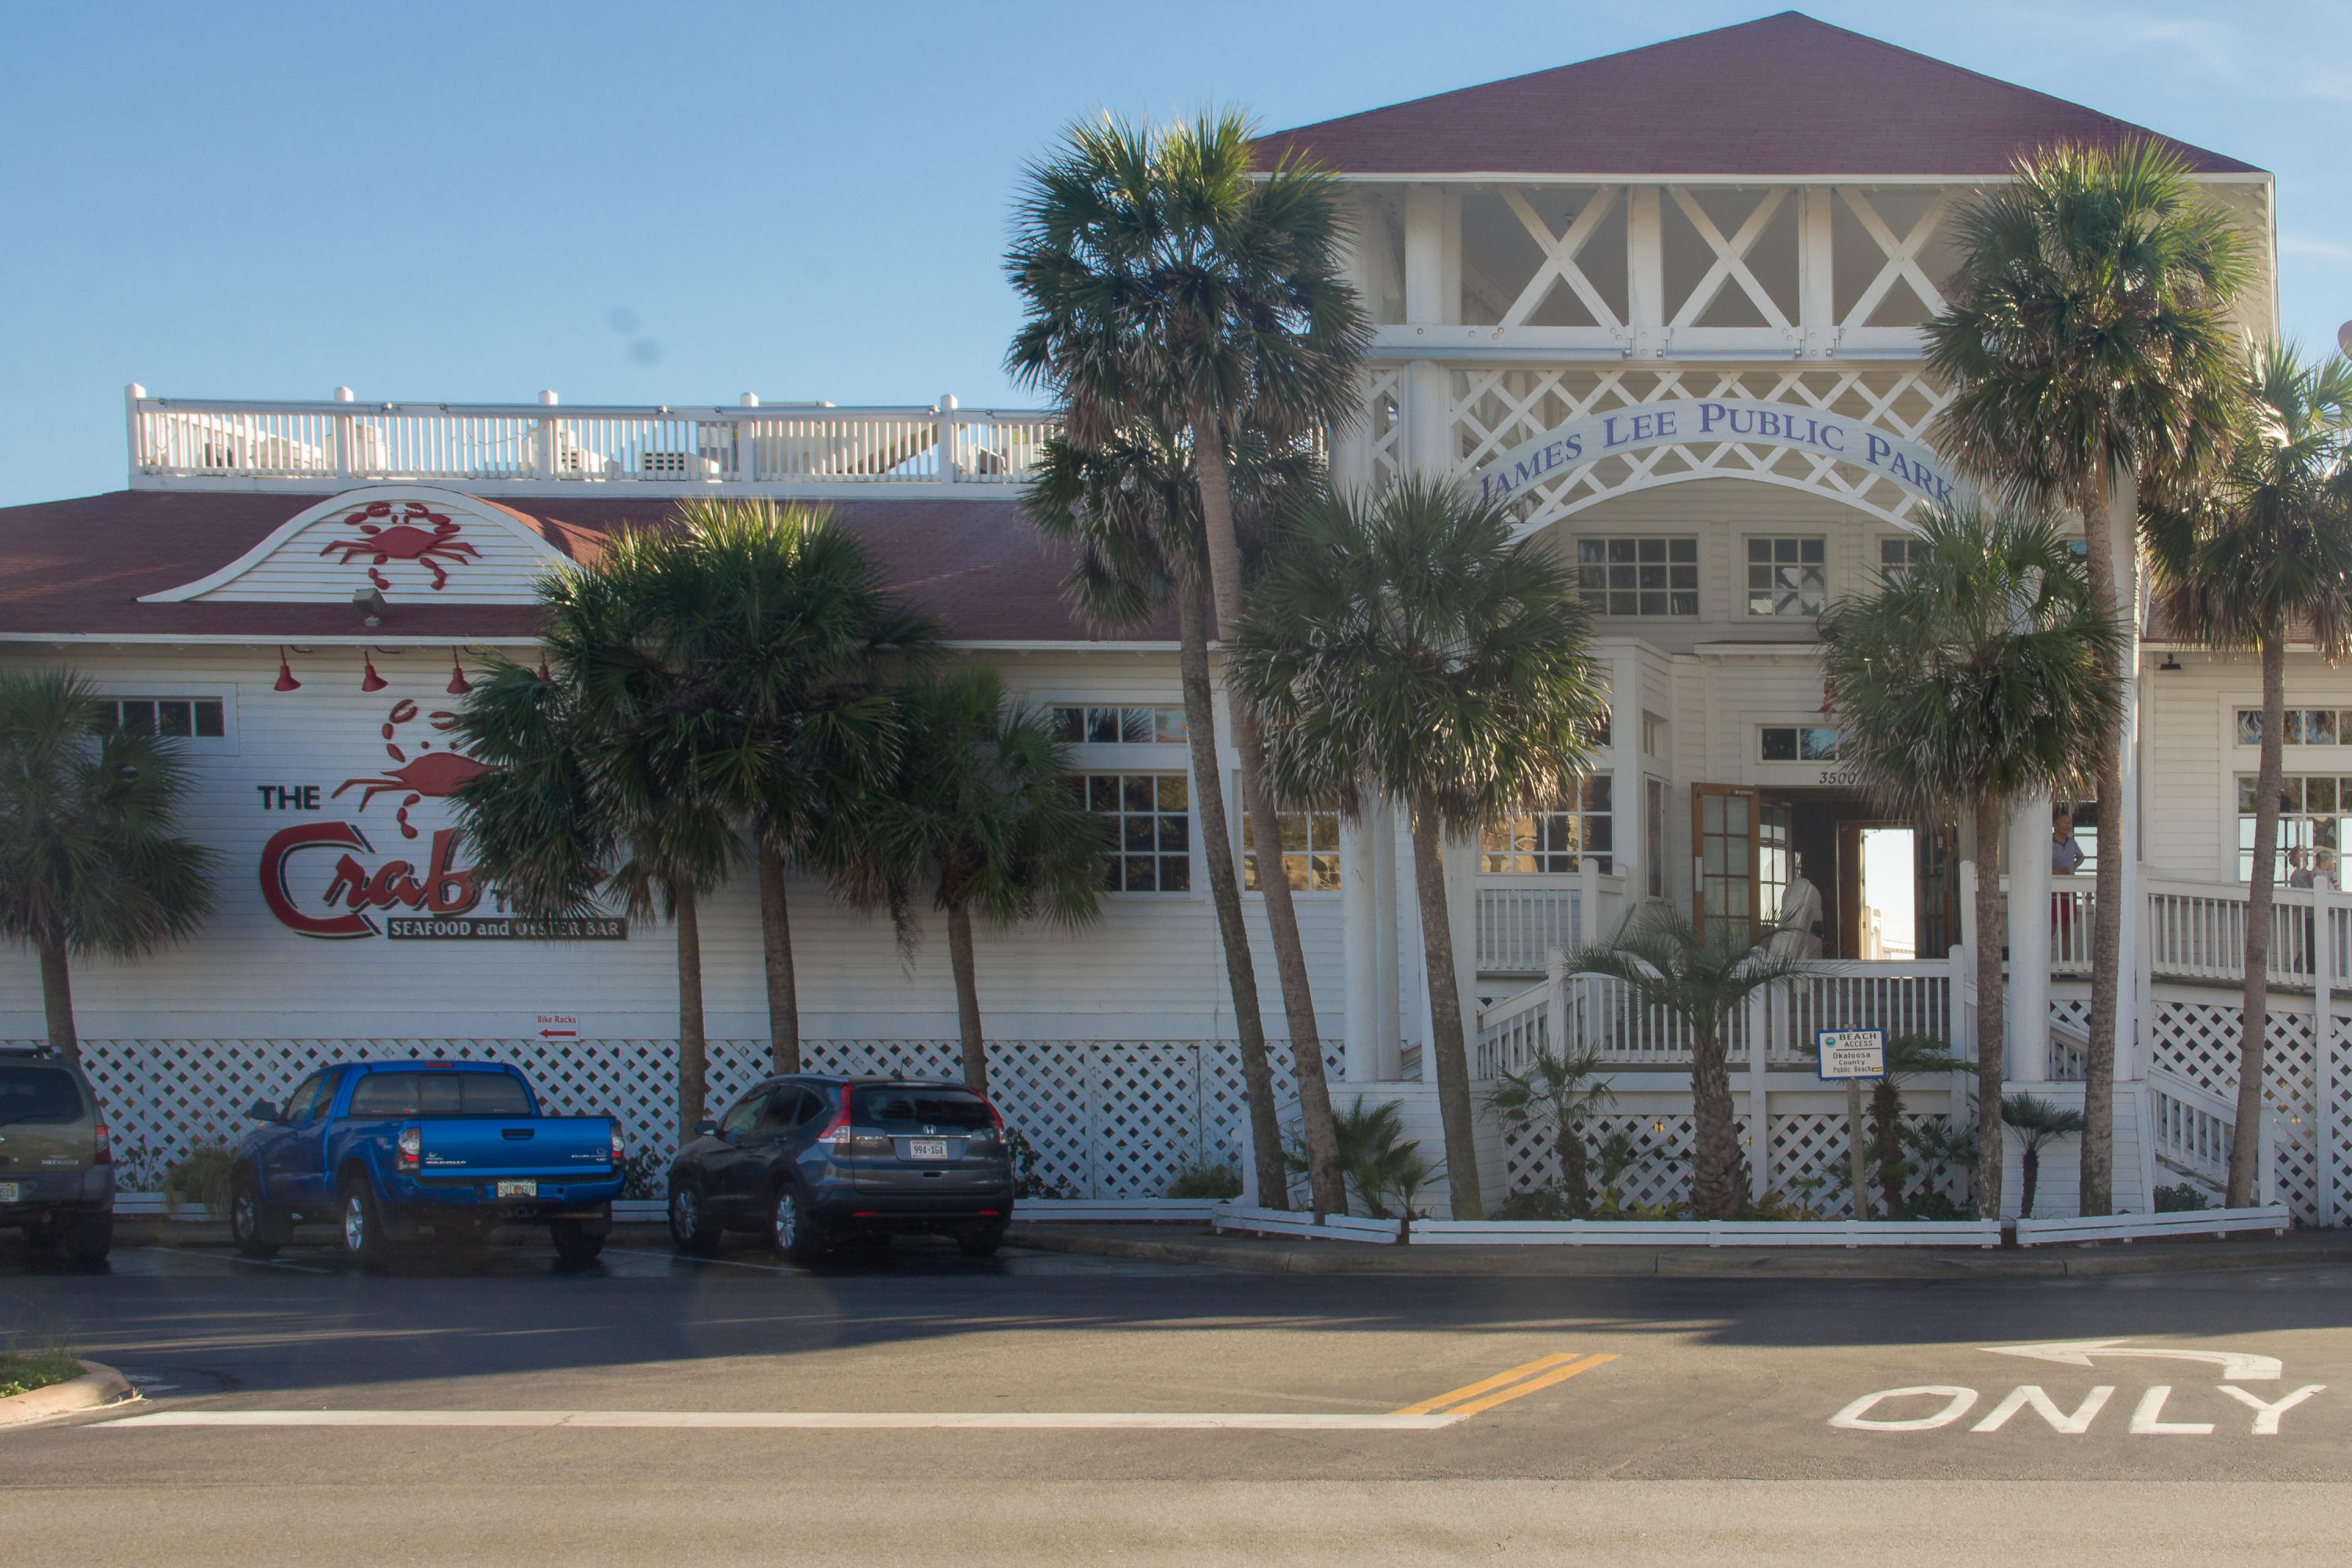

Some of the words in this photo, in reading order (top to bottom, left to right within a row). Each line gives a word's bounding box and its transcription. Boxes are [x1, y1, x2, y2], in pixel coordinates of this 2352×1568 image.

[1480, 433, 1582, 505] JAMES
[1603, 411, 1677, 448] LEE
[1698, 404, 1845, 452] PUBLIC
[1865, 433, 1957, 514] PARK
[1819, 771, 1857, 784] 3500
[257, 786, 321, 810] THE
[260, 821, 482, 938] Crab
[392, 921, 470, 935] SEAFOOD
[476, 921, 509, 935] and
[586, 921, 619, 935] BAR
[1827, 1385, 2327, 1435] ONLY
